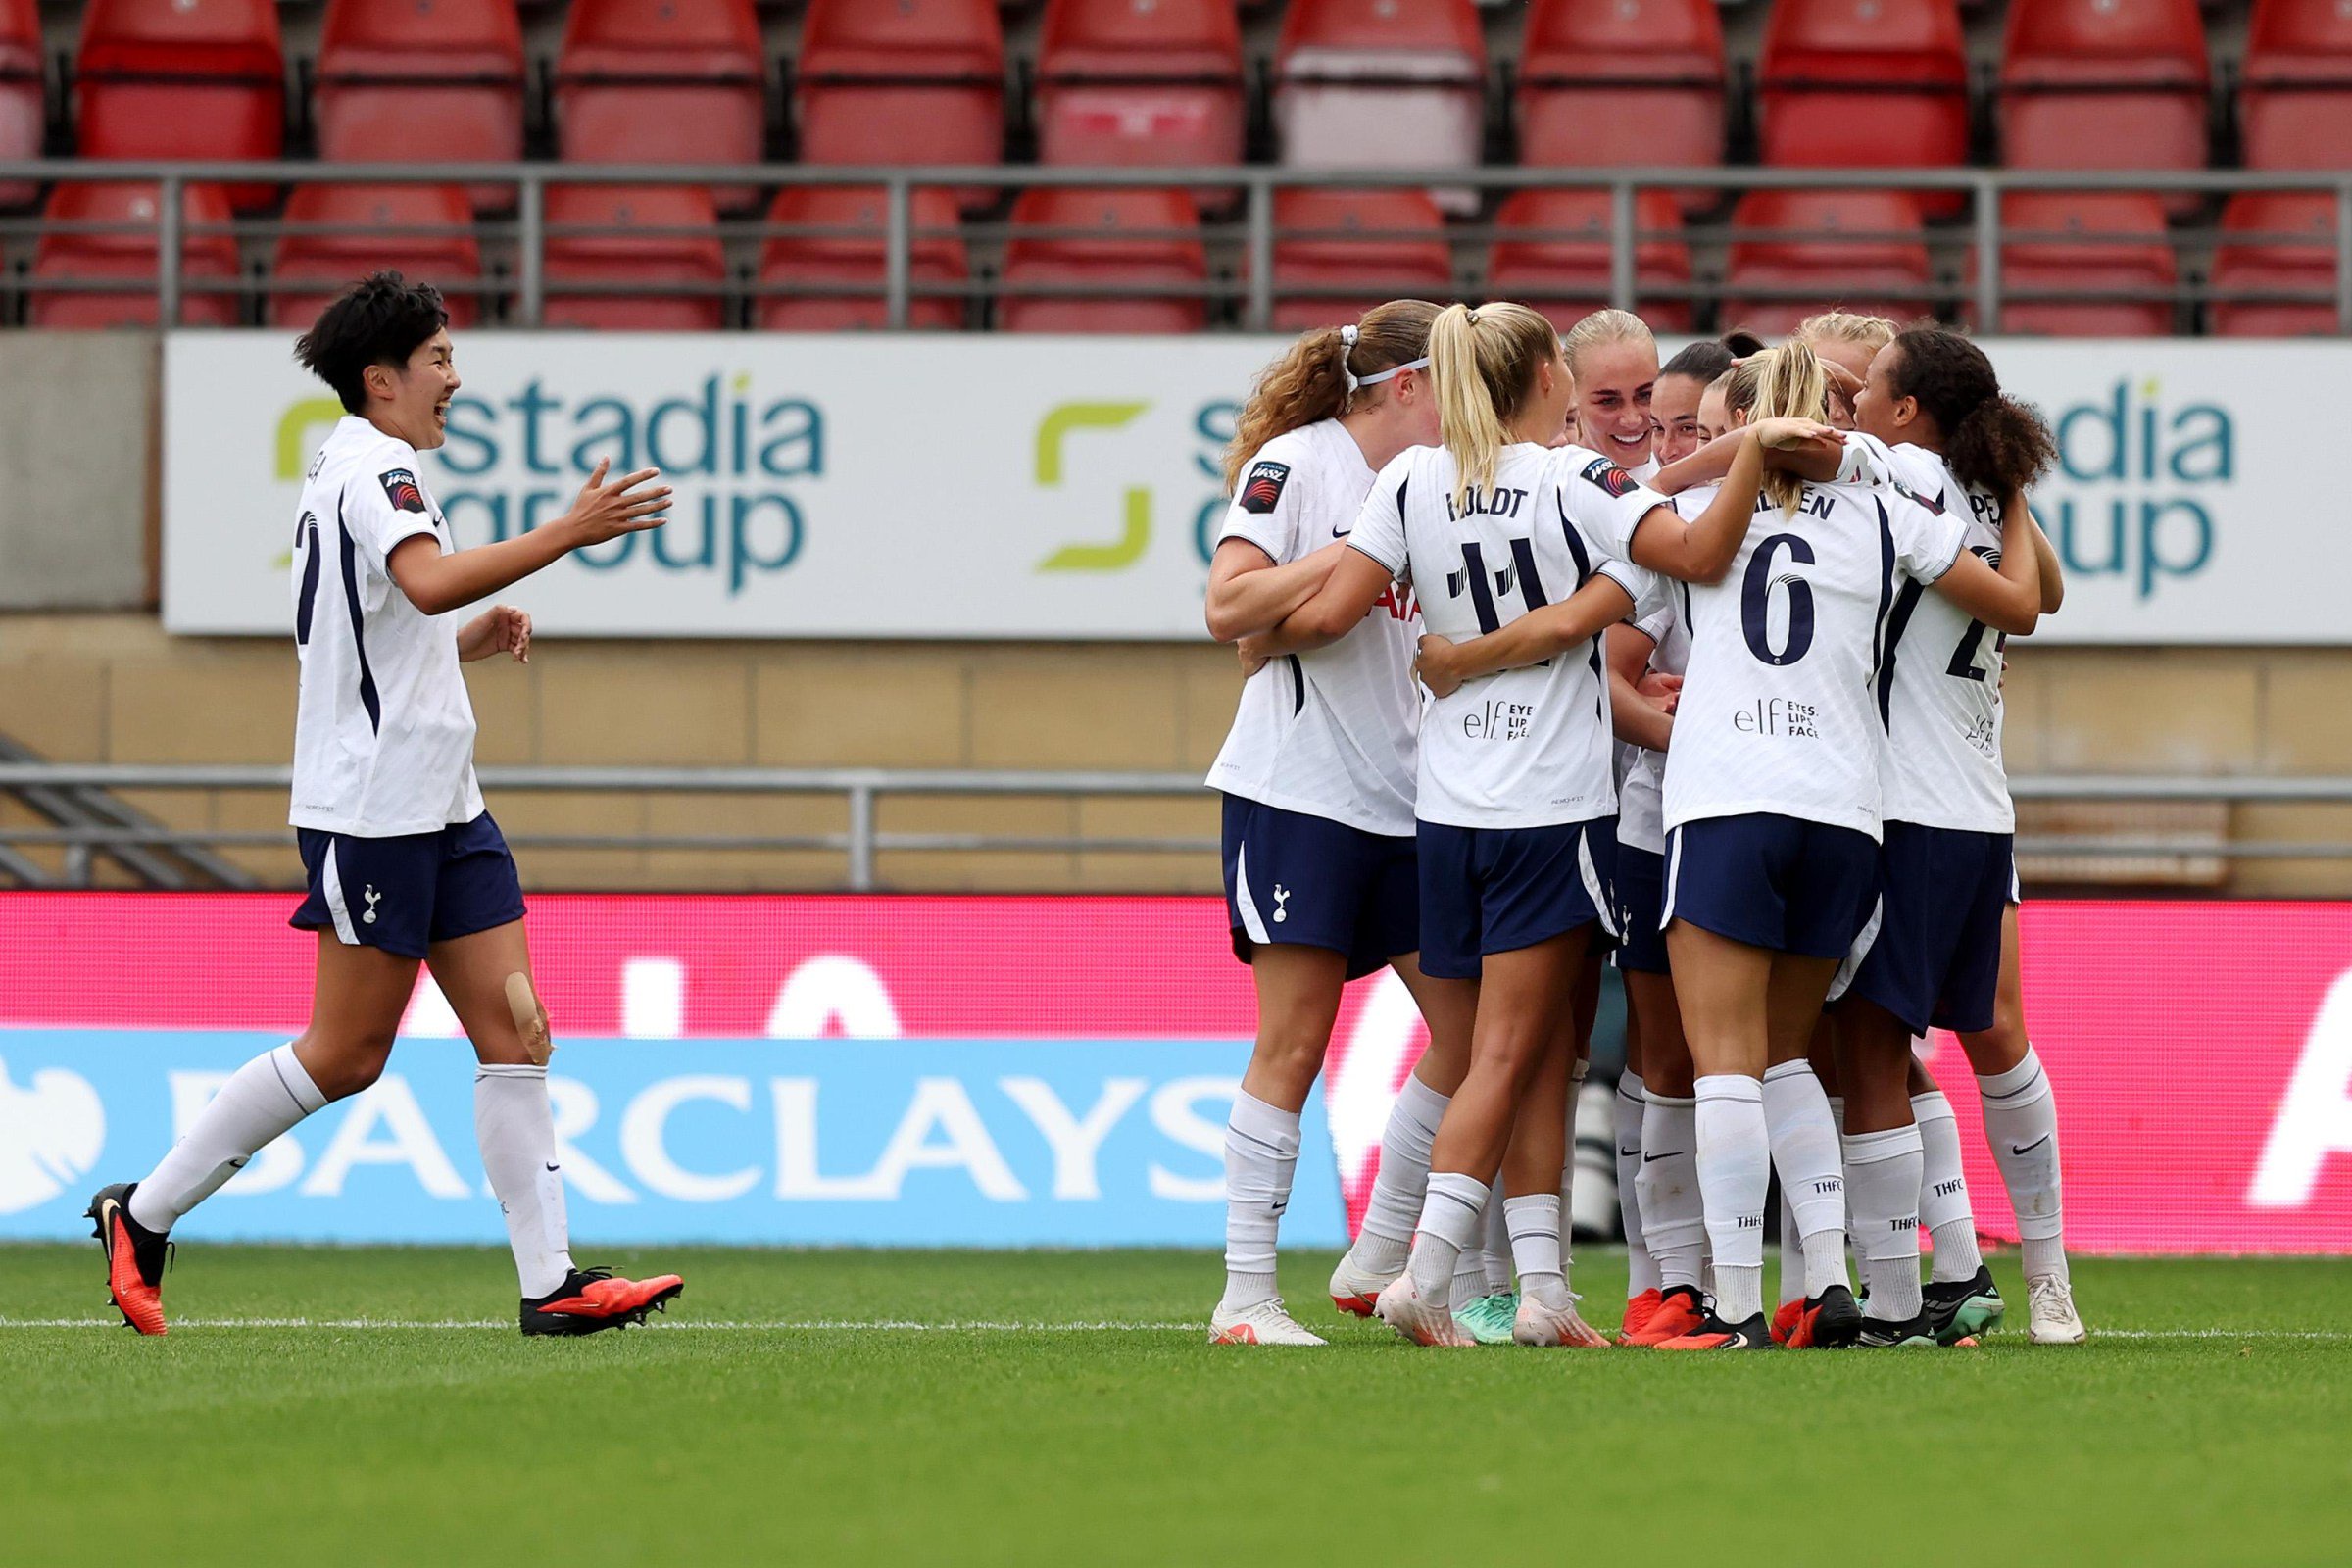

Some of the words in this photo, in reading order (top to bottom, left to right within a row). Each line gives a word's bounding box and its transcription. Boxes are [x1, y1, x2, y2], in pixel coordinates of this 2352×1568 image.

[437, 371, 824, 478] stadia
[2057, 373, 2233, 481] dia
[1446, 537, 1550, 672] 11
[1740, 532, 1816, 666] 6
[168, 1070, 1239, 1203] BARCLAYS
[1813, 1180, 1842, 1194] THFC
[1933, 1178, 1963, 1197] THFC
[1889, 1215, 1918, 1231] THFC
